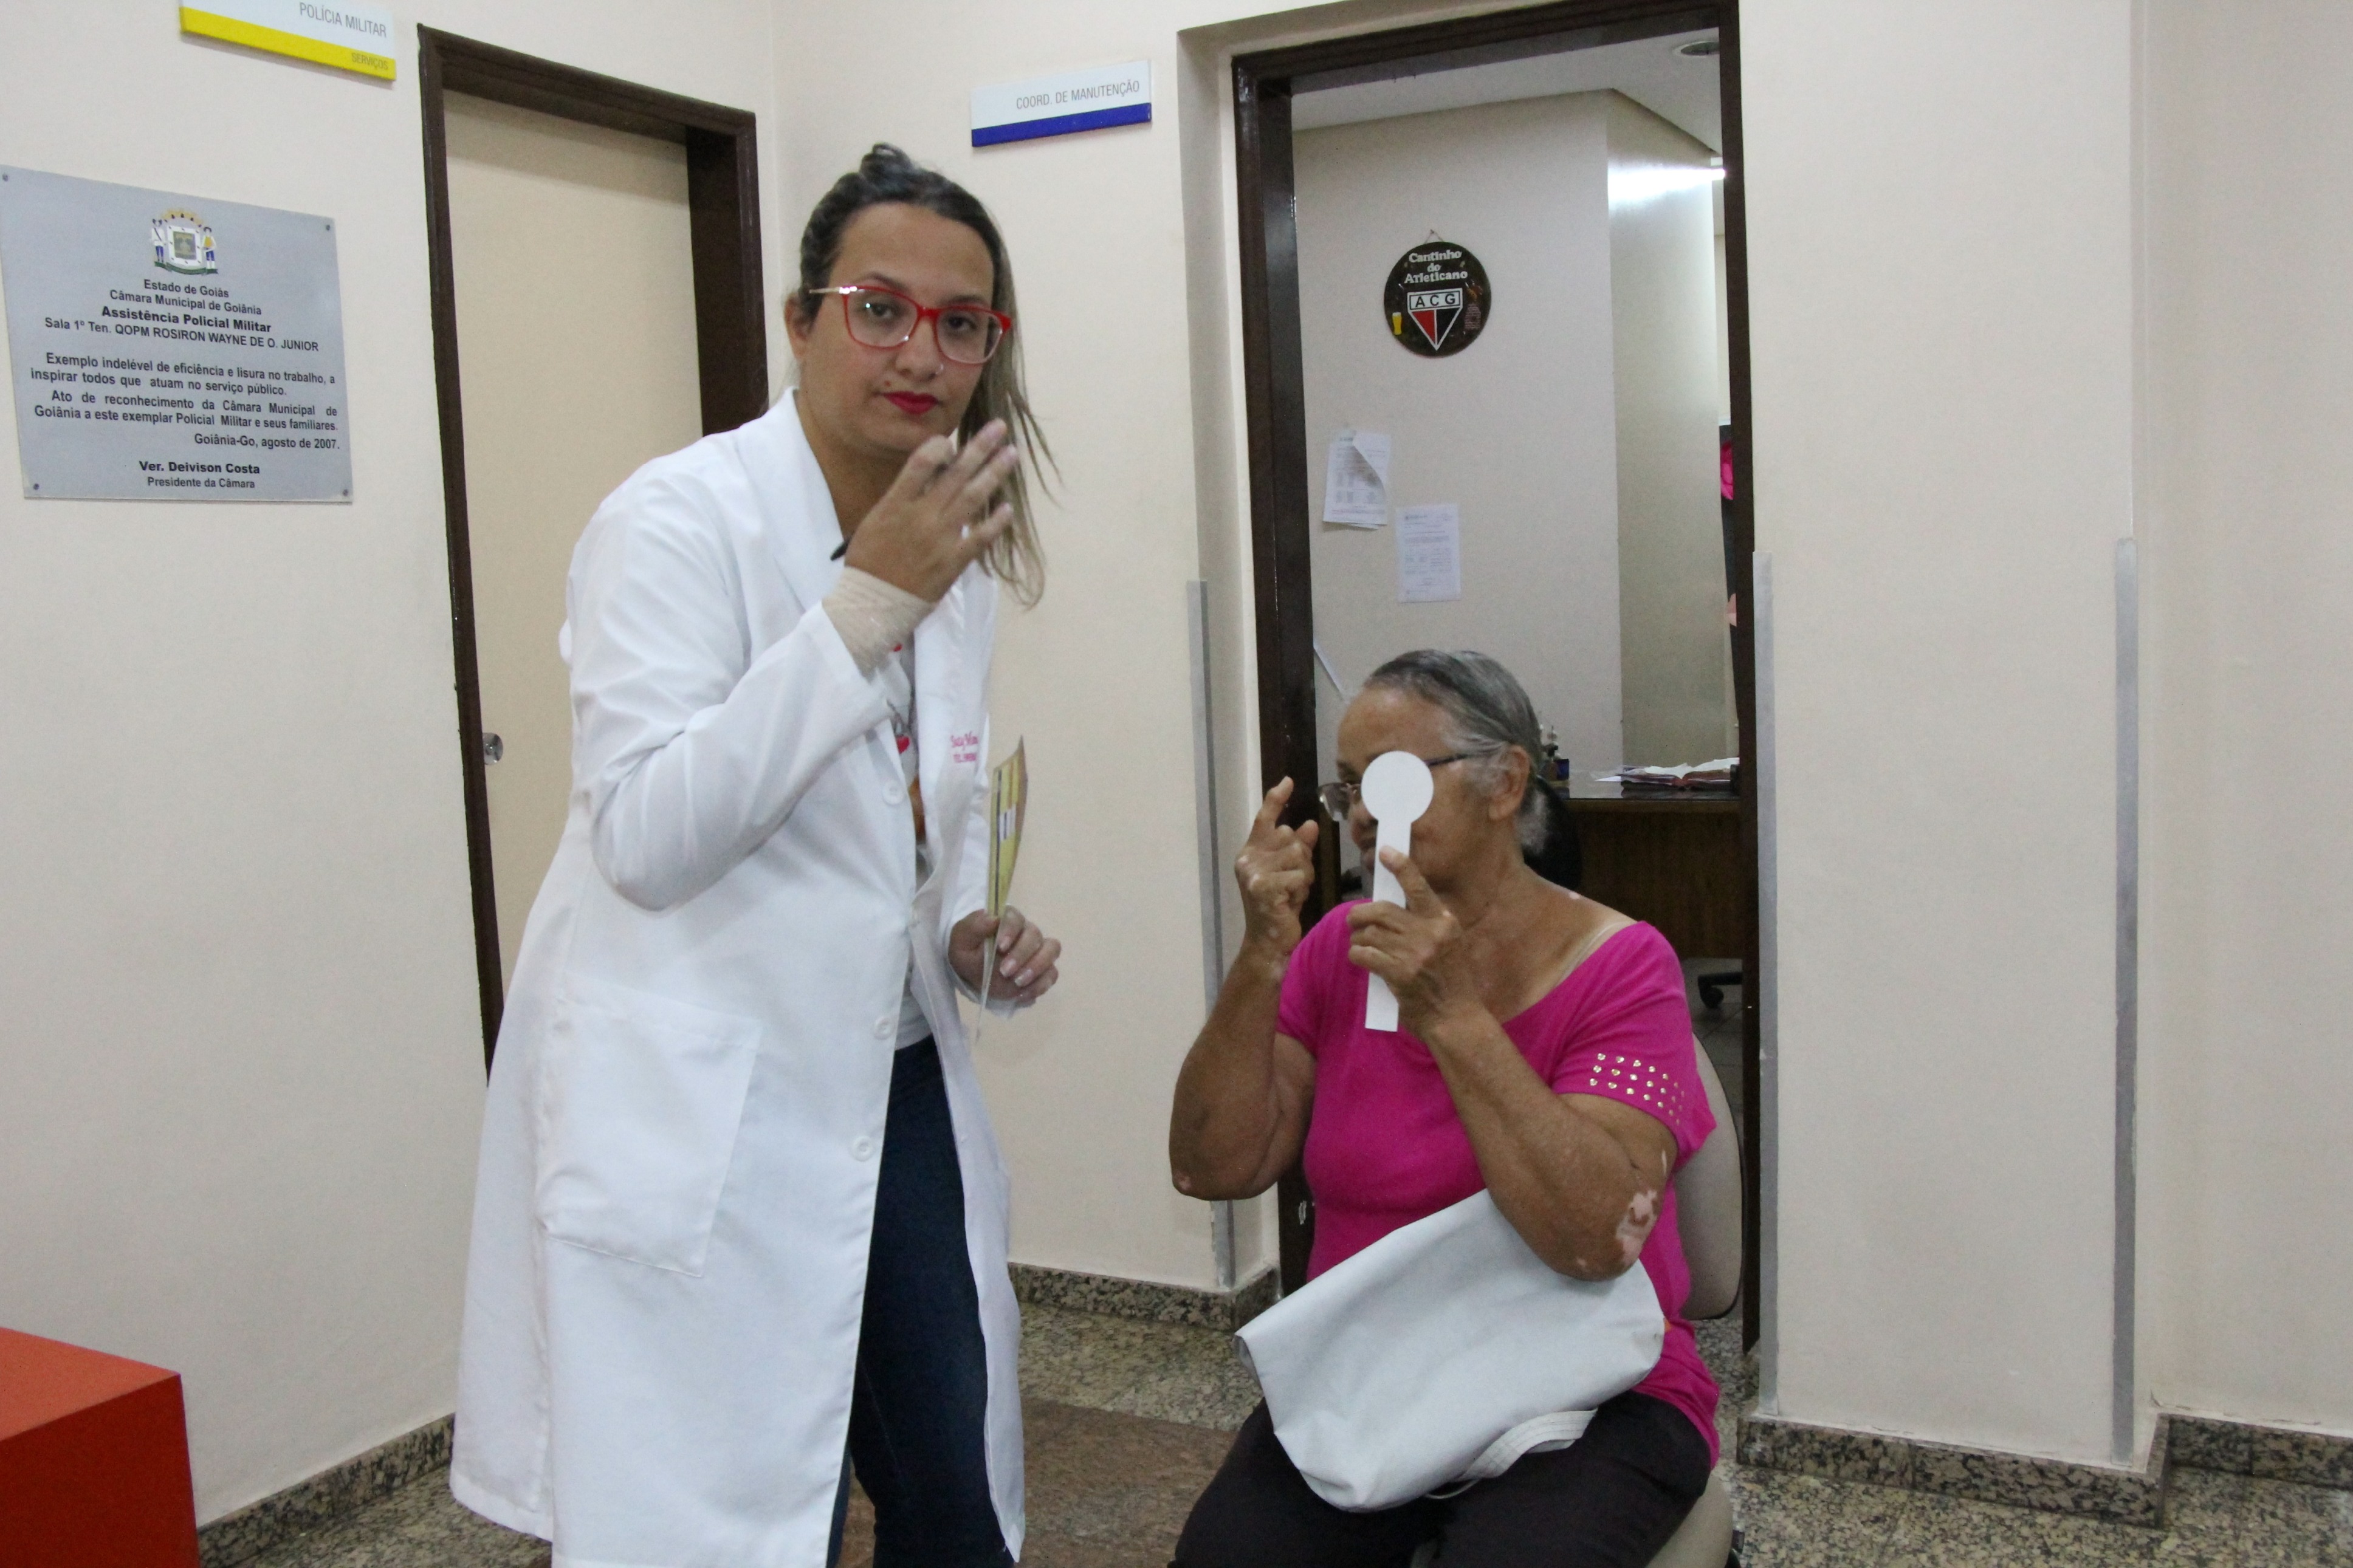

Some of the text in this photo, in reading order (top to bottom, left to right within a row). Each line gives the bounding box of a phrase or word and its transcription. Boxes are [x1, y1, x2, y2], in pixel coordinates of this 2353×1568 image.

[300, 2, 387, 38] POLÍCIA MILITAR
[351, 52, 389, 70] SERVIÇOS
[1016, 78, 1140, 109] COORD. DE MANUTENÇÃO
[1409, 249, 1463, 263] Cantinho
[1427, 262, 1442, 272] do
[144, 279, 229, 298] Estado de Goiás
[1404, 270, 1468, 284] Atleticano
[110, 289, 262, 315] Câmara Municipal de Goiânia
[101, 306, 271, 332] Assistência Policial Militar
[45, 317, 70, 329] Sala
[88, 321, 111, 333] Ten.
[115, 324, 149, 337] QOPM
[153, 327, 205, 342] ROSIRON
[208, 332, 247, 346] WAYNE
[250, 336, 264, 347] DE
[281, 339, 319, 351] JUNIOR
[31, 368, 287, 395] inspirar todos que atuam no serviço público.
[46, 352, 98, 368] Exemplo
[103, 357, 153, 371] indelével
[157, 361, 170, 372] de
[174, 363, 224, 376] eficiência
[237, 367, 265, 379] lisura
[269, 371, 281, 380] no
[284, 371, 326, 385] trabalho,
[330, 375, 335, 384] a
[52, 389, 337, 417] Ato de reconhecimento da Câmara Municipal de
[35, 405, 338, 431] Goiânia a este exemplar Policial Militar e seus familiares.
[194, 433, 340, 450] Goiânia-Go, agosto de 2007.
[139, 460, 260, 474] Ver. Deivison Costa
[148, 476, 255, 488] Presidente da Câmara
